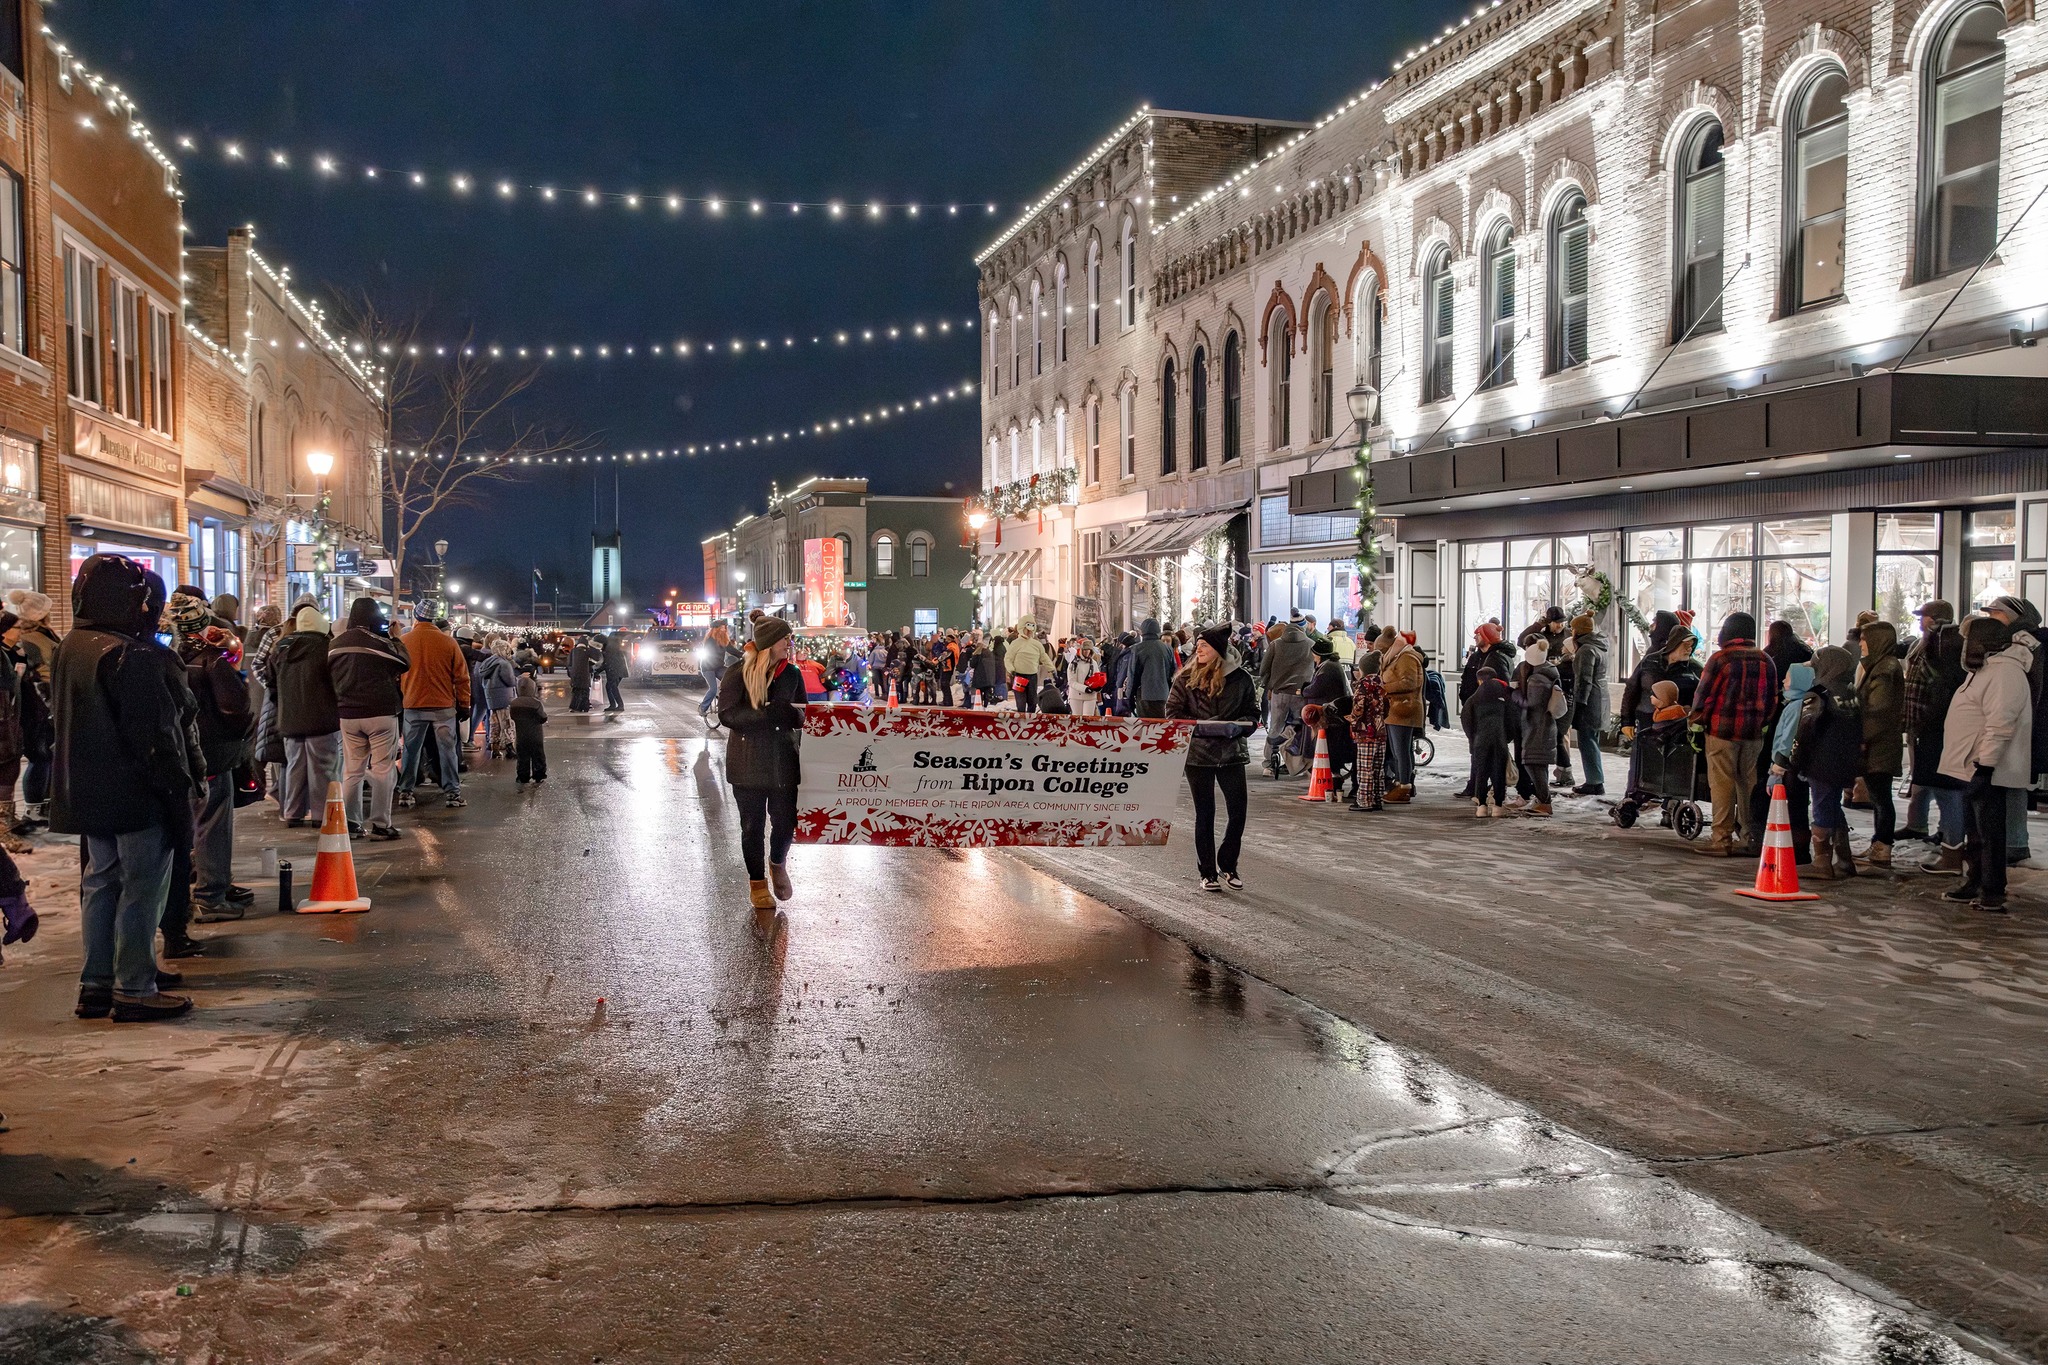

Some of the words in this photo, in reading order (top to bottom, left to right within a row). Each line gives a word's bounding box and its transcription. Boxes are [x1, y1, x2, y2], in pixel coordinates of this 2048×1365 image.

[823, 556, 835, 618] DICKENS
[913, 751, 1023, 770] Season's
[1031, 754, 1149, 778] Greetings
[837, 773, 889, 788] RIPON
[913, 775, 953, 793] from
[961, 773, 1034, 795] Ripon
[1043, 776, 1129, 798] College
[835, 798, 842, 806] A
[845, 797, 882, 807] PROUD
[885, 799, 929, 808] MEMBER
[931, 799, 946, 808] OF
[949, 800, 969, 809] THE
[971, 800, 1001, 809] RIPON
[1003, 801, 1030, 810] AREA
[1032, 801, 1092, 812] COMMUNITY
[1093, 803, 1121, 812] SINCE
